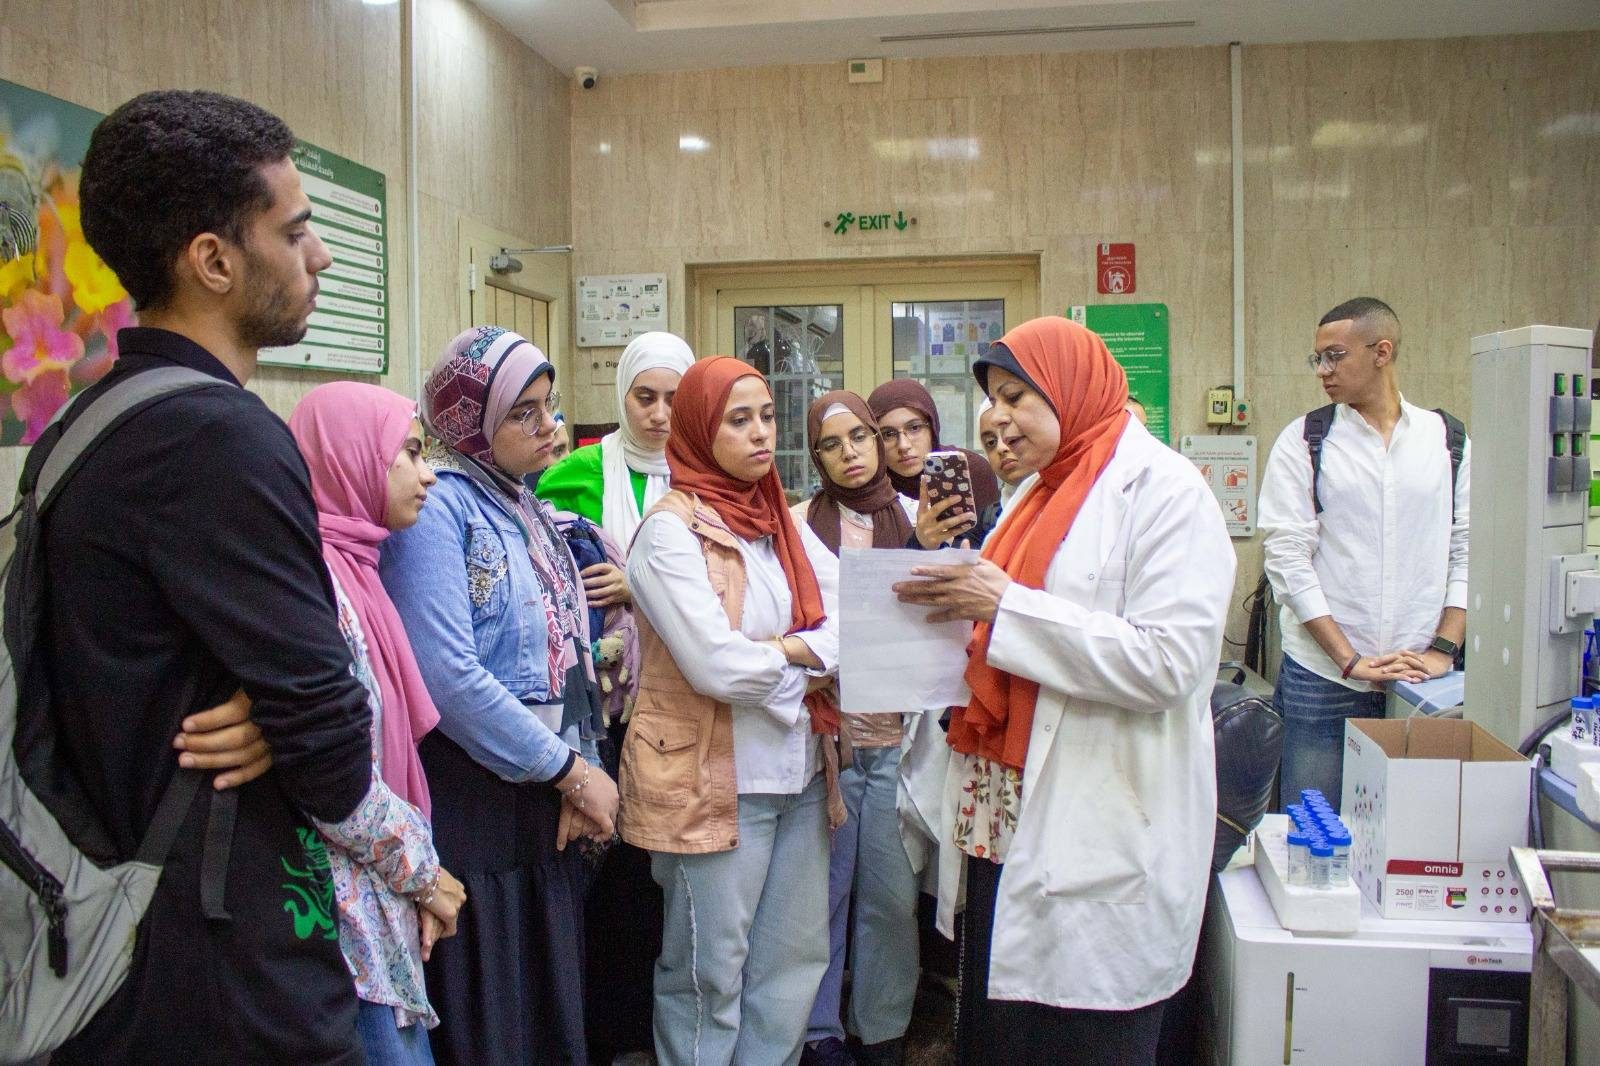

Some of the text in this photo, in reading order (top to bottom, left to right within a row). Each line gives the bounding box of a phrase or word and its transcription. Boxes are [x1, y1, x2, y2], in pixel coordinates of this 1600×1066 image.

[859, 214, 891, 230] EXIT
[1424, 863, 1459, 875] omnia
[1395, 888, 1414, 896] 2500
